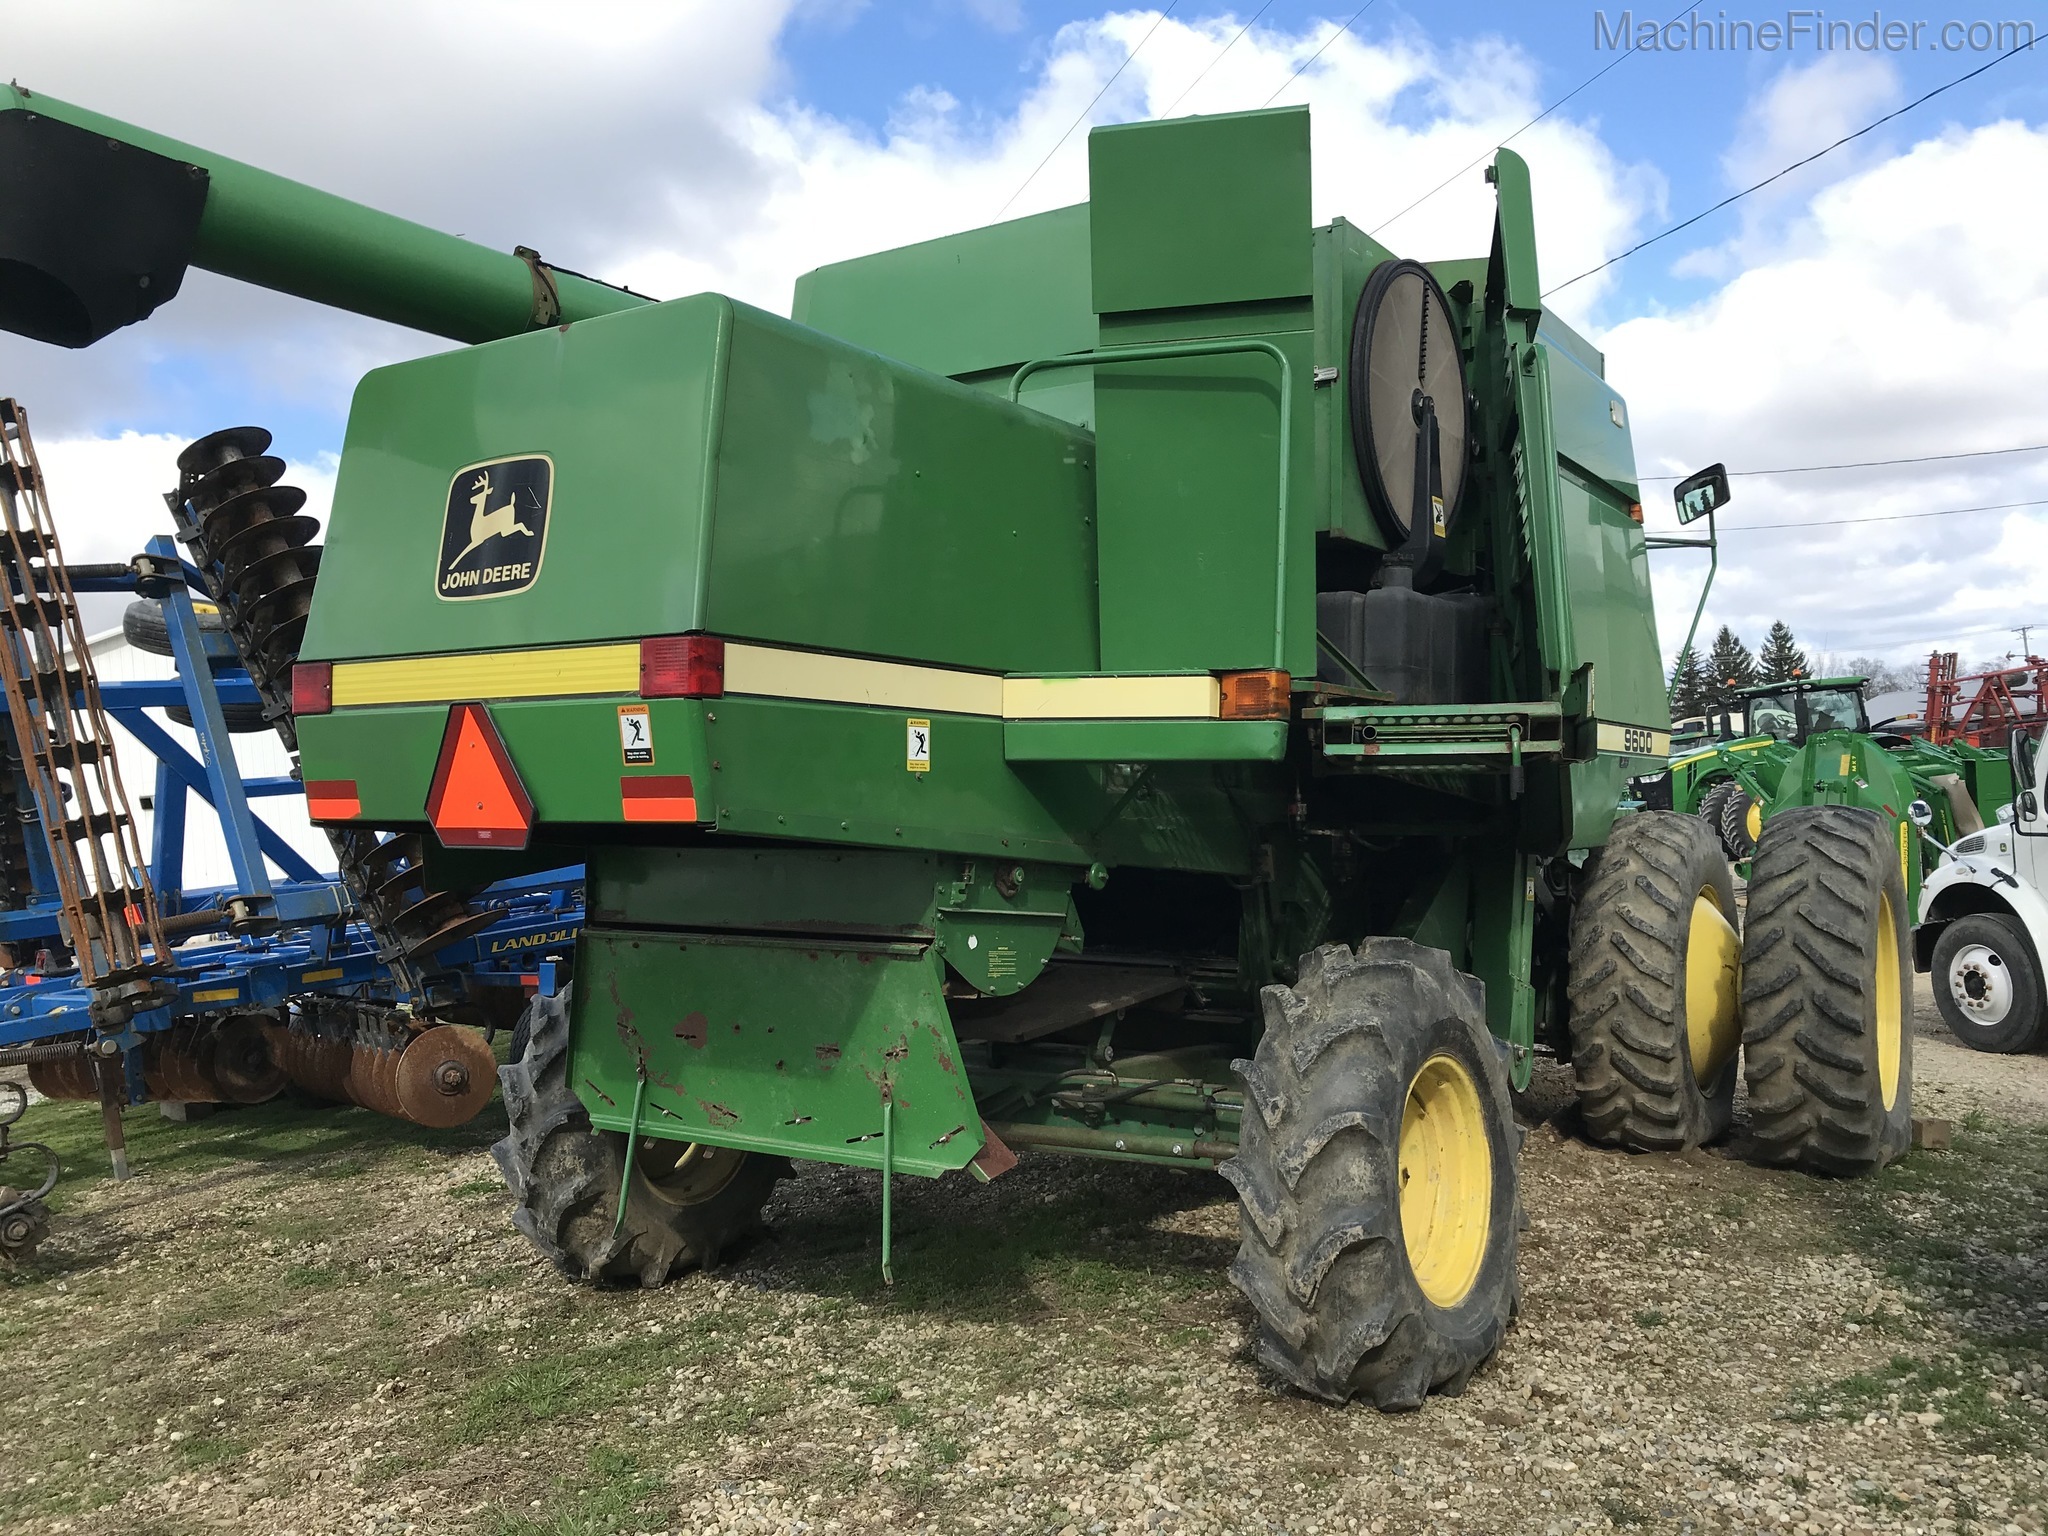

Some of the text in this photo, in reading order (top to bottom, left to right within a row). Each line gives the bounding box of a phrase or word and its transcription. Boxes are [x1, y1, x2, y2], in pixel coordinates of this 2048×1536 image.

[441, 562, 531, 590] JOHN DEERE
[1624, 728, 1652, 754] 9600
